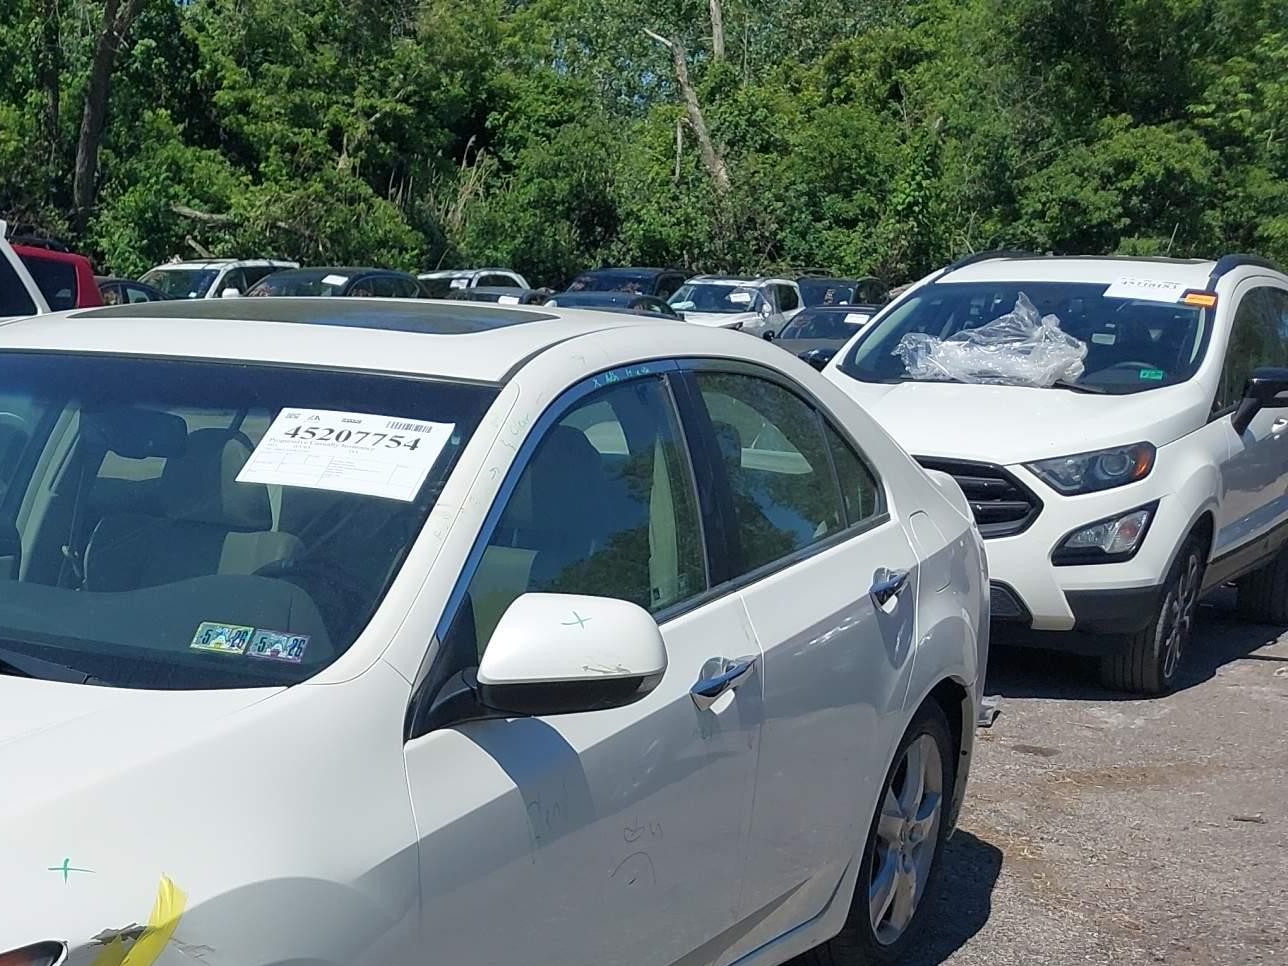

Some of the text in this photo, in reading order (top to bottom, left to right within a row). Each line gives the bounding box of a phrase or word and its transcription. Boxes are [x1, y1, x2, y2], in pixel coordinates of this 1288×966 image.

[284, 425, 422, 451] 45207754
[201, 630, 213, 644] 5
[257, 637, 306, 657] 5 26
